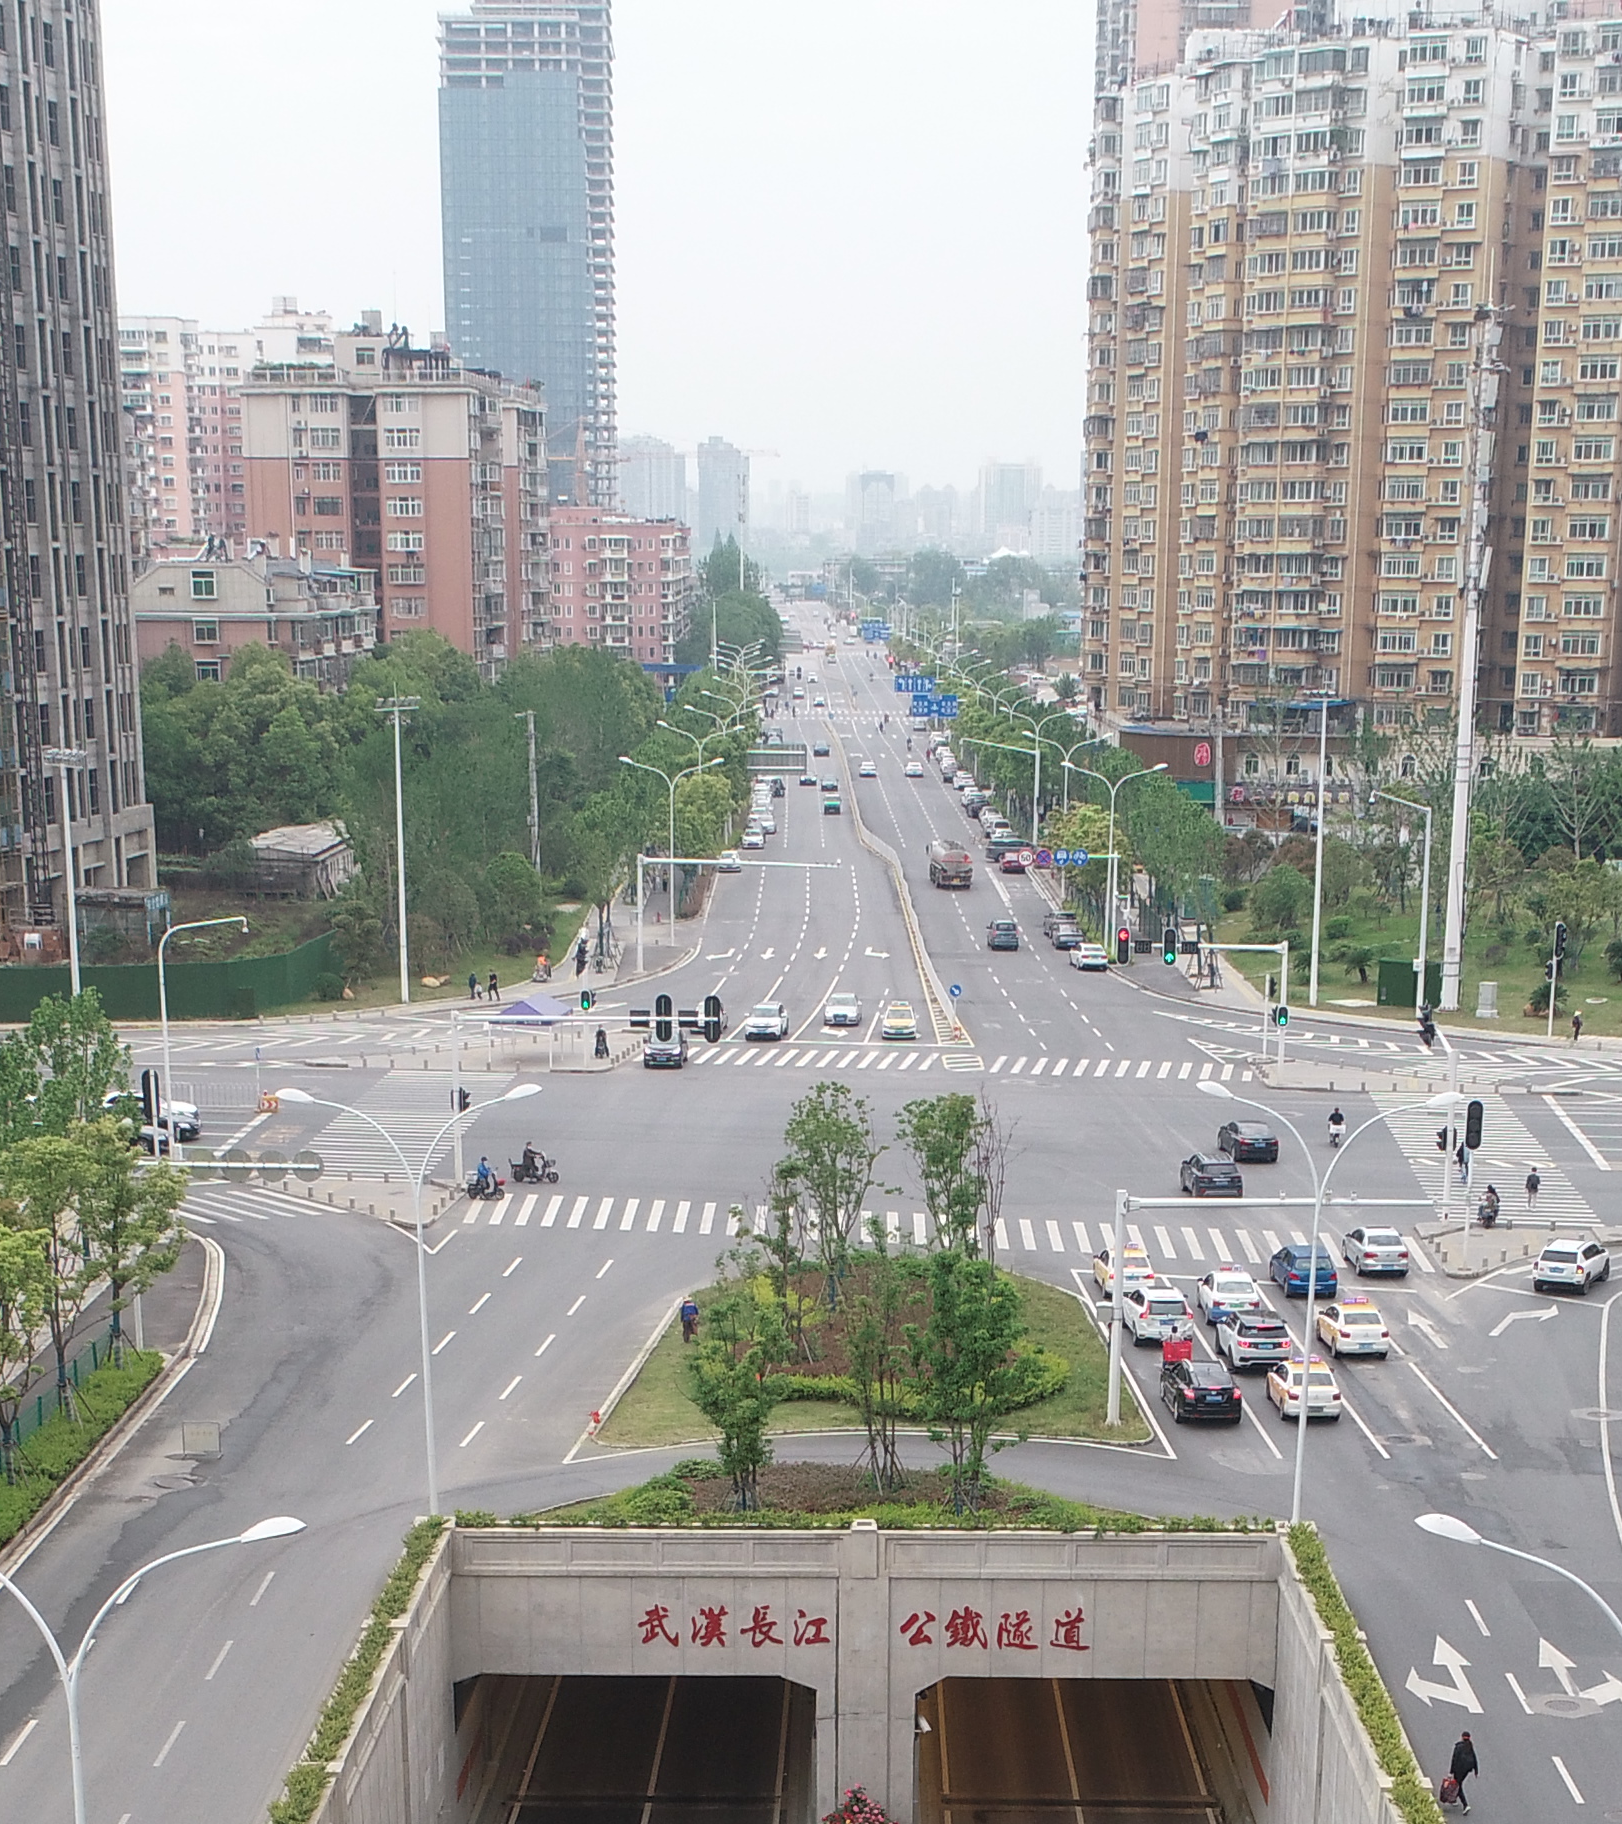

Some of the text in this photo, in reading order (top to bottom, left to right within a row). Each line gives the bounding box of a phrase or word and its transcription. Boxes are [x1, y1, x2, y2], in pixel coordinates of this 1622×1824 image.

[637, 1605, 1090, 1652] 武漢長江 公鐵隧道
